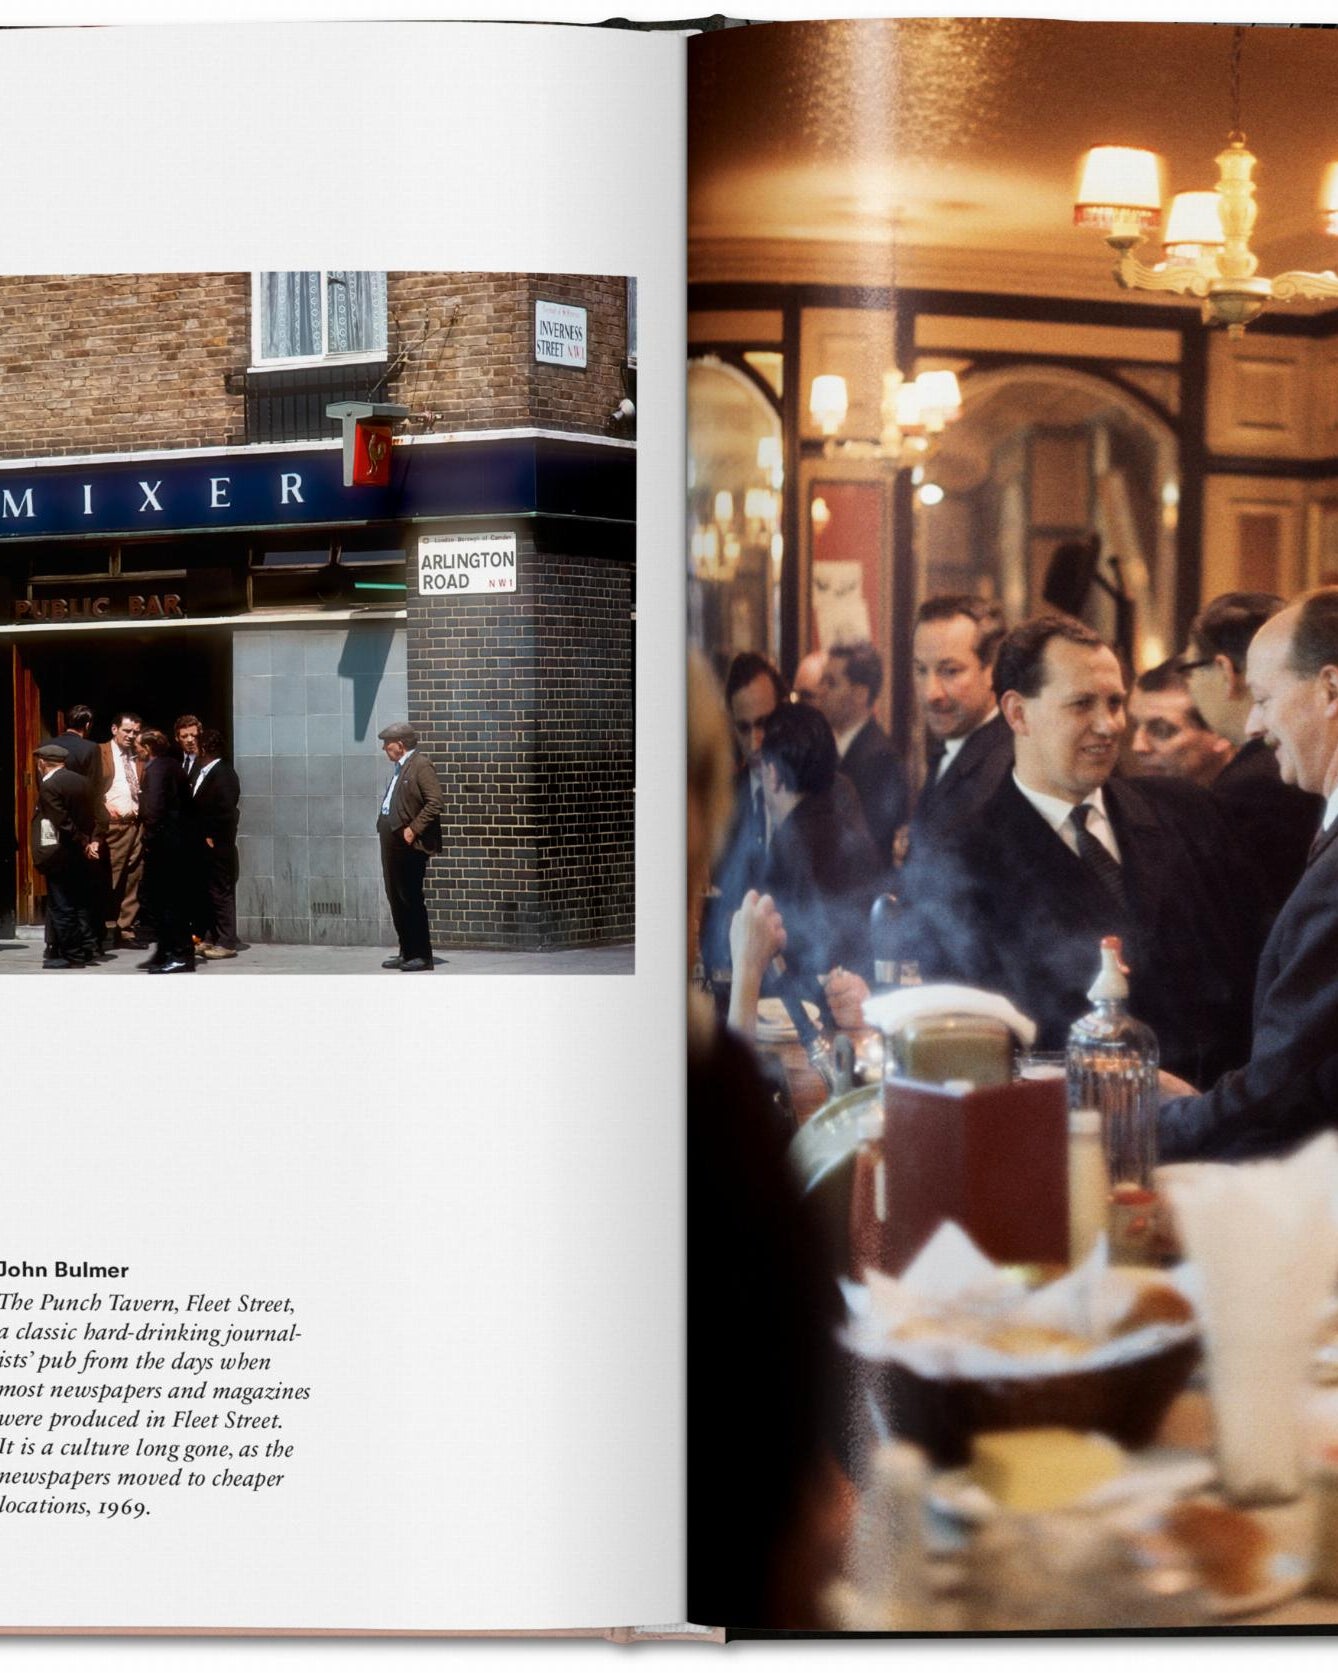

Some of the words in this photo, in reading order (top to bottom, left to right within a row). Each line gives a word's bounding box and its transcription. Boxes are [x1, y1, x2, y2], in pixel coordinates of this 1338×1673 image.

[540, 320, 583, 341] INVERNESS
[537, 340, 564, 357] STREET
[2, 473, 304, 518] MIXER
[421, 551, 514, 570] ARLINGTON
[423, 573, 470, 590] ROAD
[14, 597, 110, 620] PUBLIC
[128, 593, 183, 617] BAR
[0, 1261, 47, 1277] John
[55, 1262, 129, 1278] Bulmer
[0, 1293, 33, 1310] The
[41, 1293, 101, 1311] Punch
[109, 1294, 178, 1313] Tavern,
[187, 1294, 231, 1312] Fleet
[238, 1295, 294, 1314] Street,
[0, 1328, 9, 1339] a
[16, 1322, 77, 1340] classic
[84, 1322, 221, 1346] hard-drinking
[220, 1324, 301, 1347] journal-
[0, 1350, 34, 1368] ists’
[37, 1351, 76, 1373] pub
[78, 1350, 128, 1374] from
[136, 1352, 165, 1369] the
[172, 1352, 213, 1375] days
[221, 1352, 270, 1370] when
[0, 1384, 44, 1397] most
[51, 1384, 162, 1403] newspapers
[168, 1381, 207, 1398] and
[213, 1382, 310, 1404] magazines
[0, 1414, 42, 1426] were
[48, 1409, 140, 1431] produced
[147, 1410, 165, 1427] in
[173, 1410, 219, 1428] Fleet
[225, 1411, 282, 1428] Street.
[0, 1438, 14, 1454] It
[21, 1437, 35, 1455] is
[41, 1443, 53, 1455] a
[61, 1438, 129, 1456] culture
[136, 1438, 179, 1462] long
[183, 1445, 233, 1462] gone,
[239, 1445, 258, 1457] as
[266, 1440, 293, 1457] the
[0, 1471, 110, 1489] newspapers
[118, 1468, 182, 1486] moved
[188, 1472, 205, 1486] to
[212, 1469, 284, 1491] cheaper
[0, 1495, 90, 1516] locations,
[99, 1499, 150, 1519] 1969.
